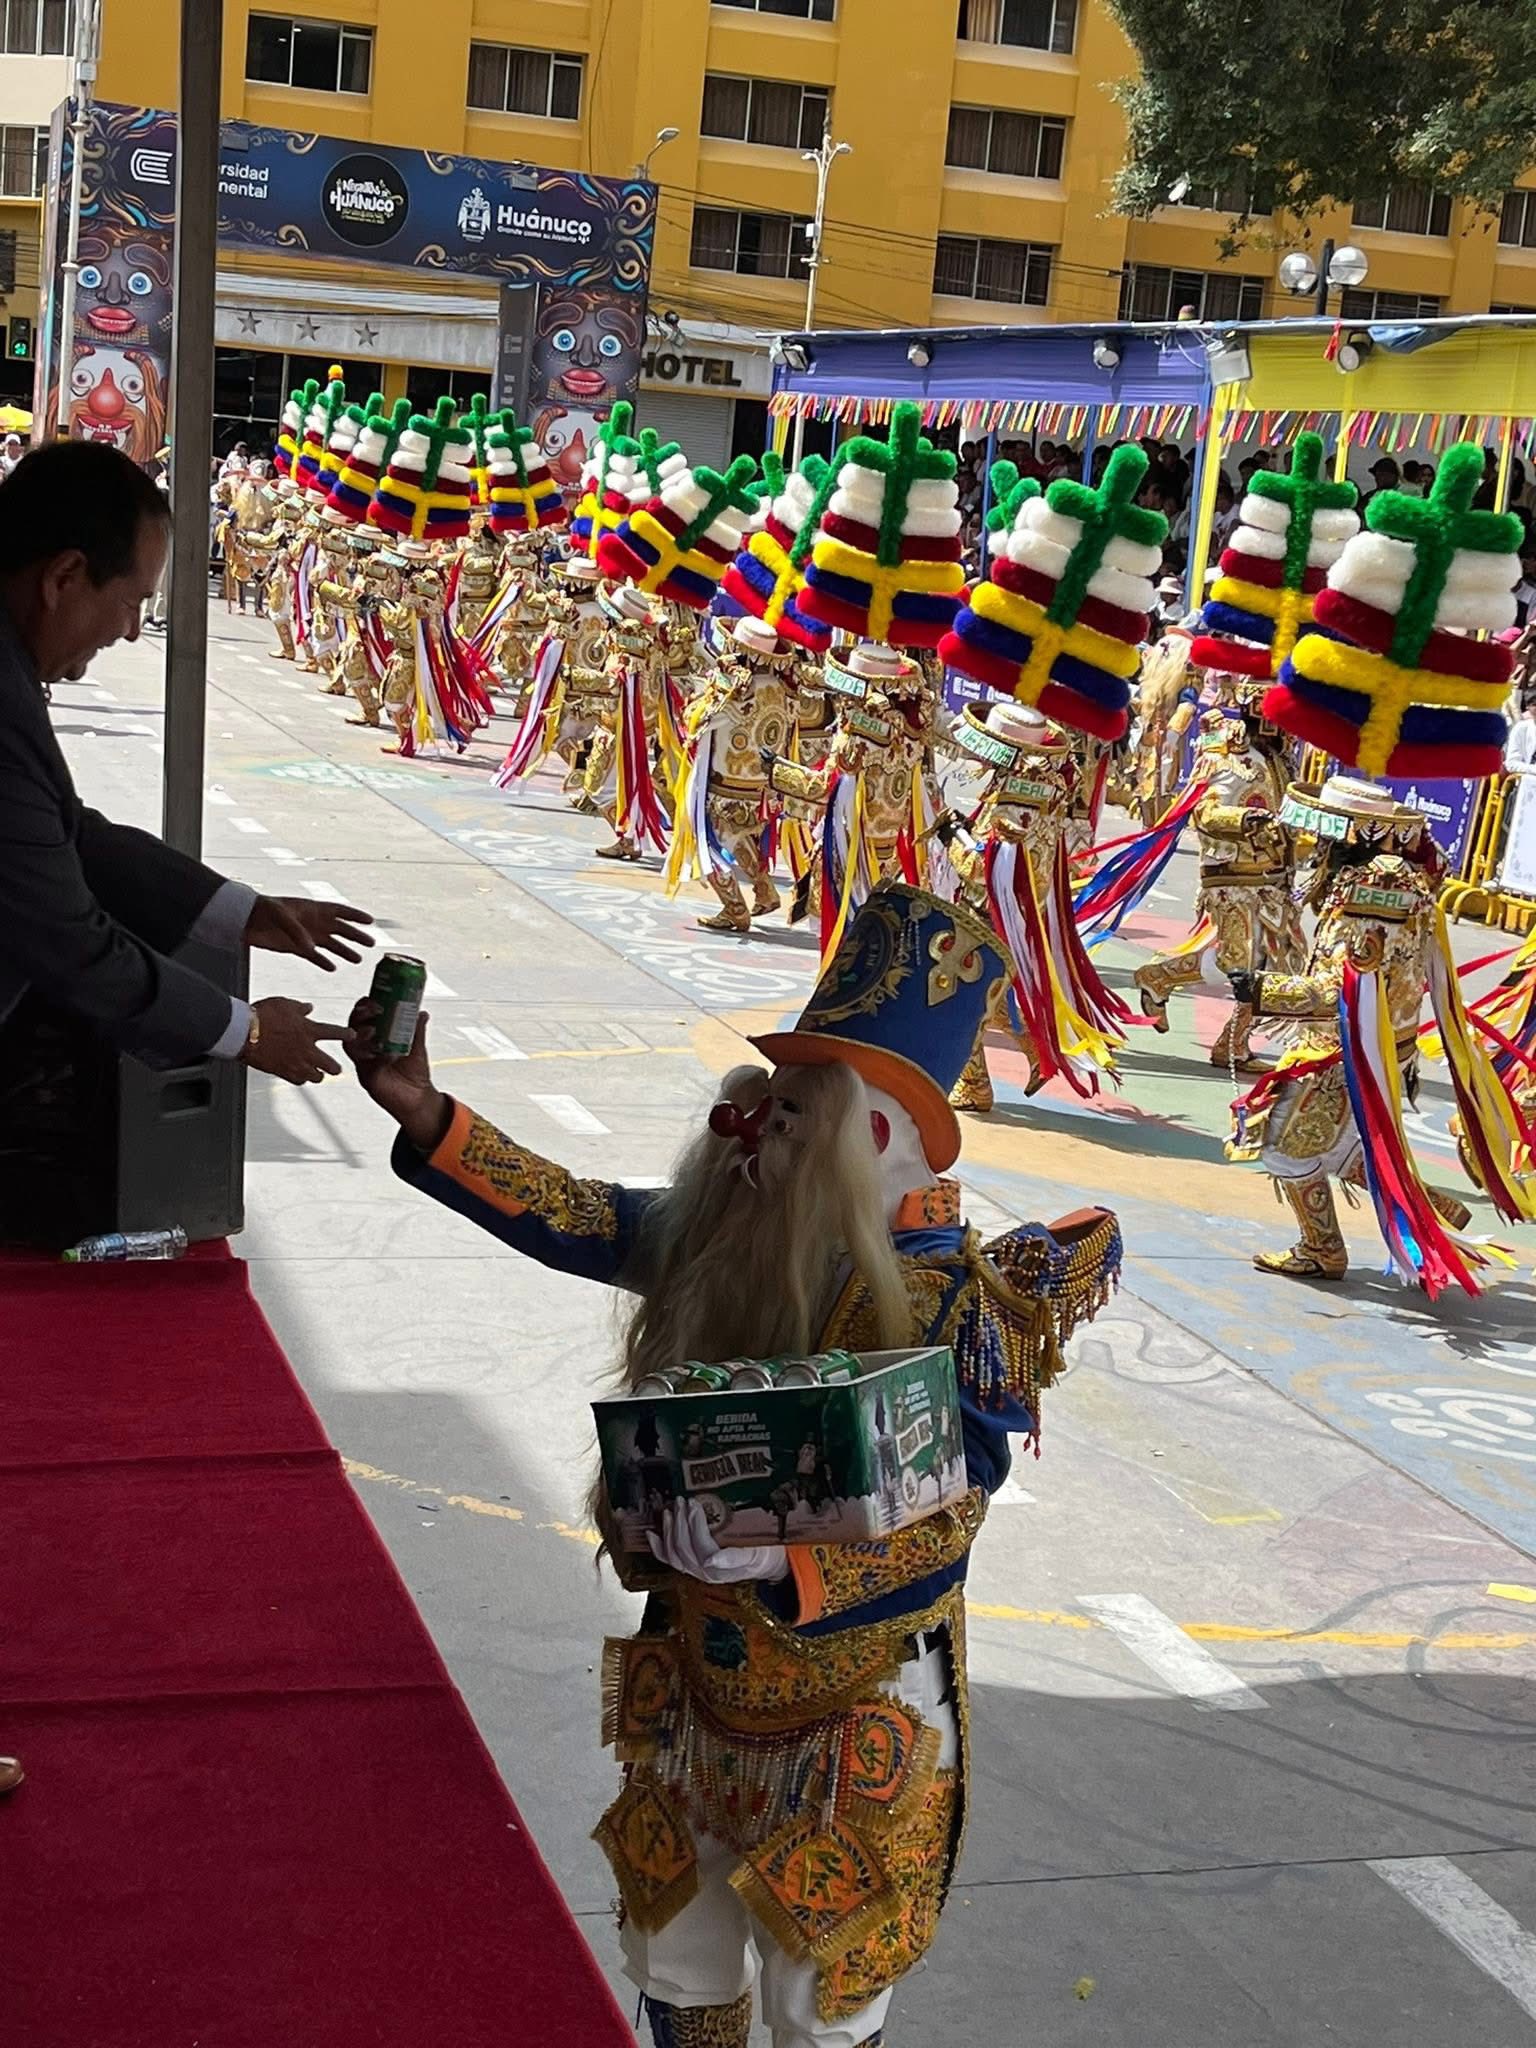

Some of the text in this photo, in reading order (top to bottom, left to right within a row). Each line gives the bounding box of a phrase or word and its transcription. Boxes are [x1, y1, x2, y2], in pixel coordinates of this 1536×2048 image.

[218, 163, 270, 182] rsidad
[218, 181, 268, 199] nental
[641, 352, 742, 387] HOTEL
[1008, 779, 1051, 798] REAL
[1355, 888, 1409, 909] REAL
[715, 1413, 758, 1425] BEBIDA
